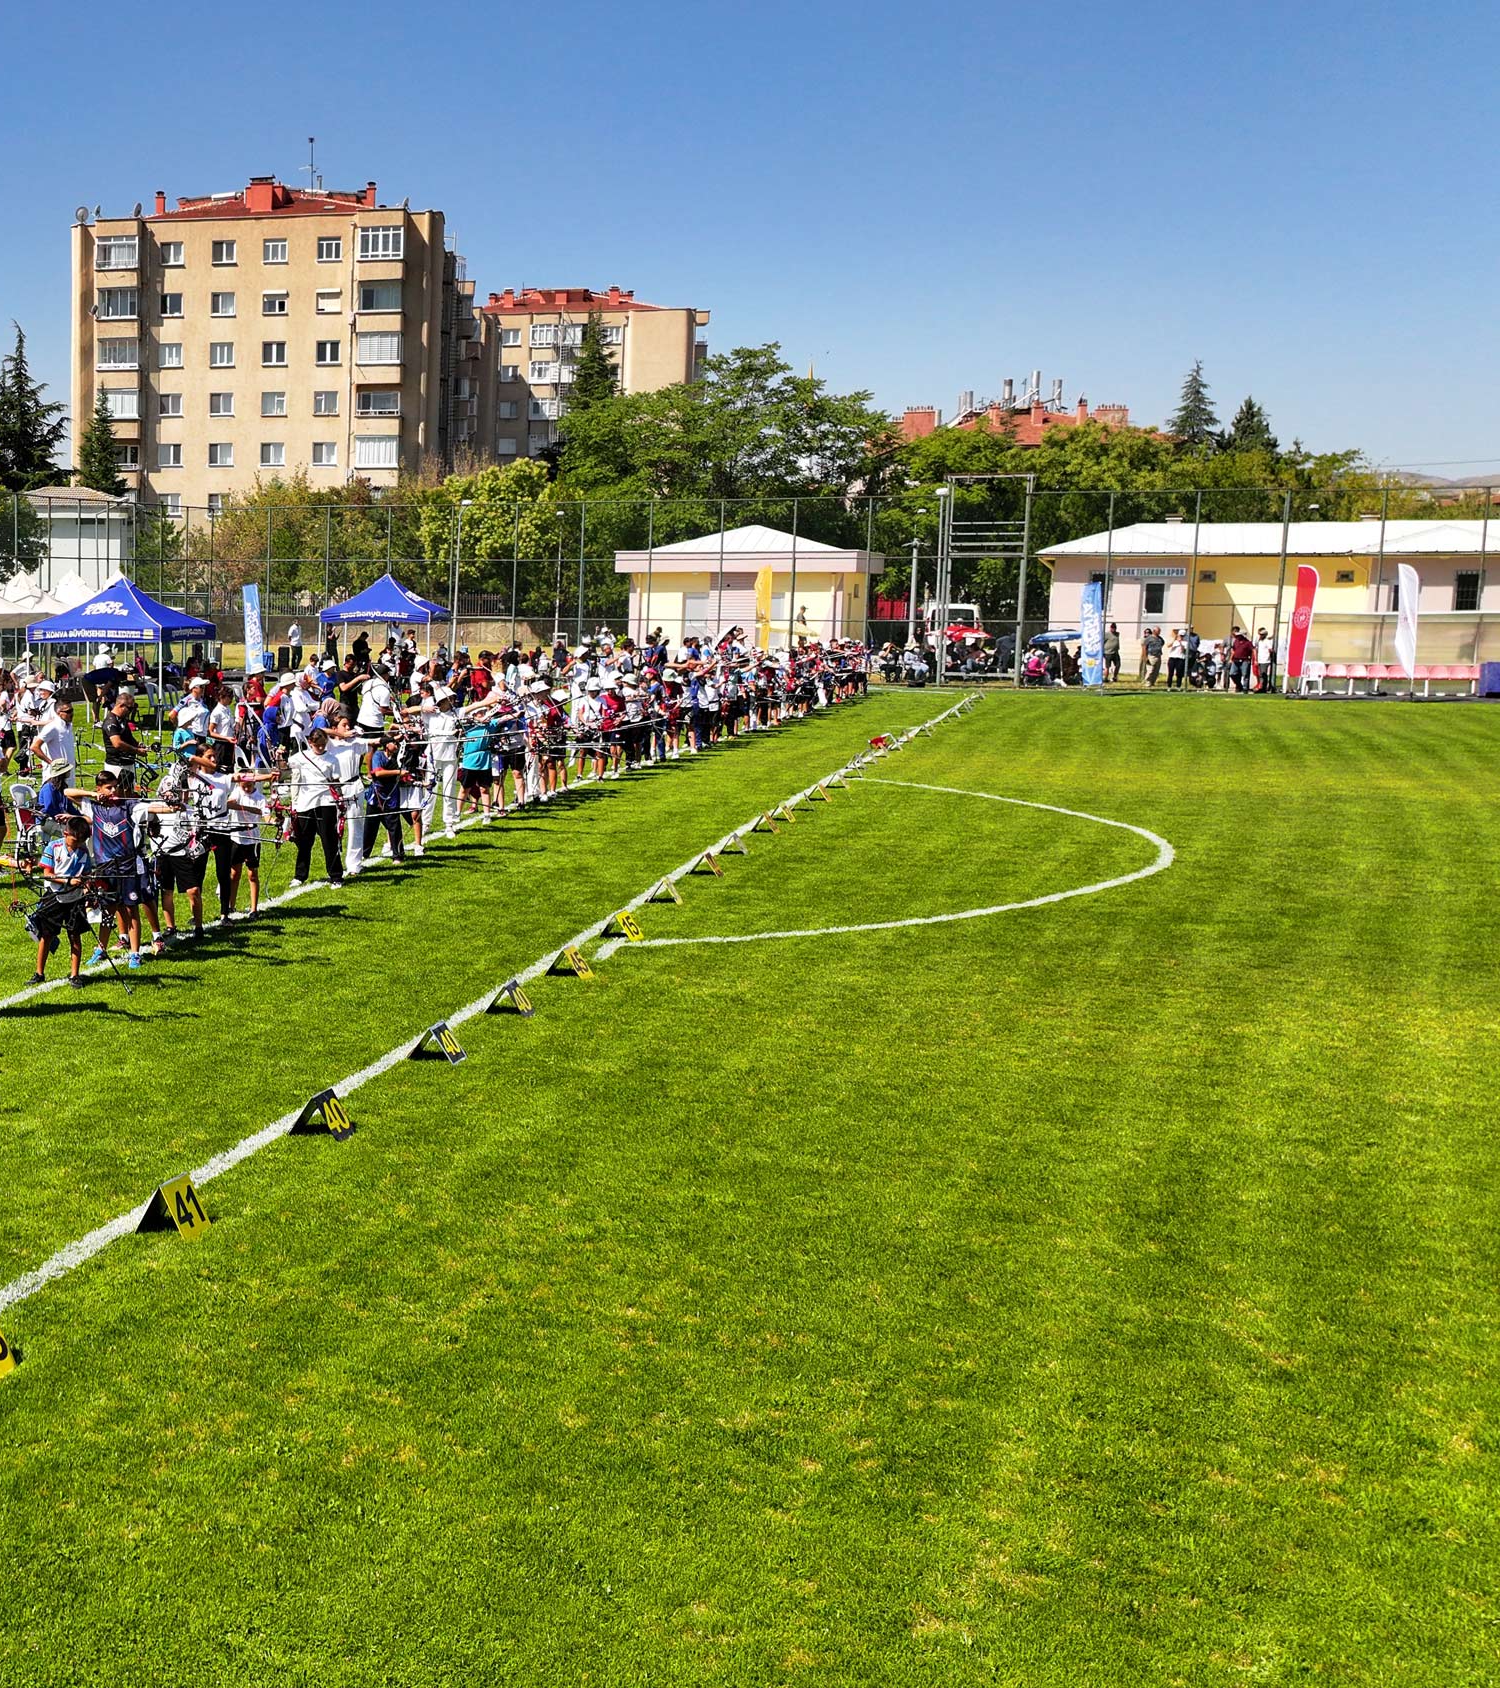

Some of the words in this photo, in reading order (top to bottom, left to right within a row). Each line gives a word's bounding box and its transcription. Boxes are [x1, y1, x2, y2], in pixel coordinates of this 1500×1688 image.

[45, 630, 68, 639] KONYA
[621, 915, 640, 938] 15
[569, 951, 589, 975] 45
[512, 986, 532, 1013] 40
[440, 1029, 461, 1056] 40
[323, 1097, 350, 1133] 40
[175, 1184, 206, 1228] 41
